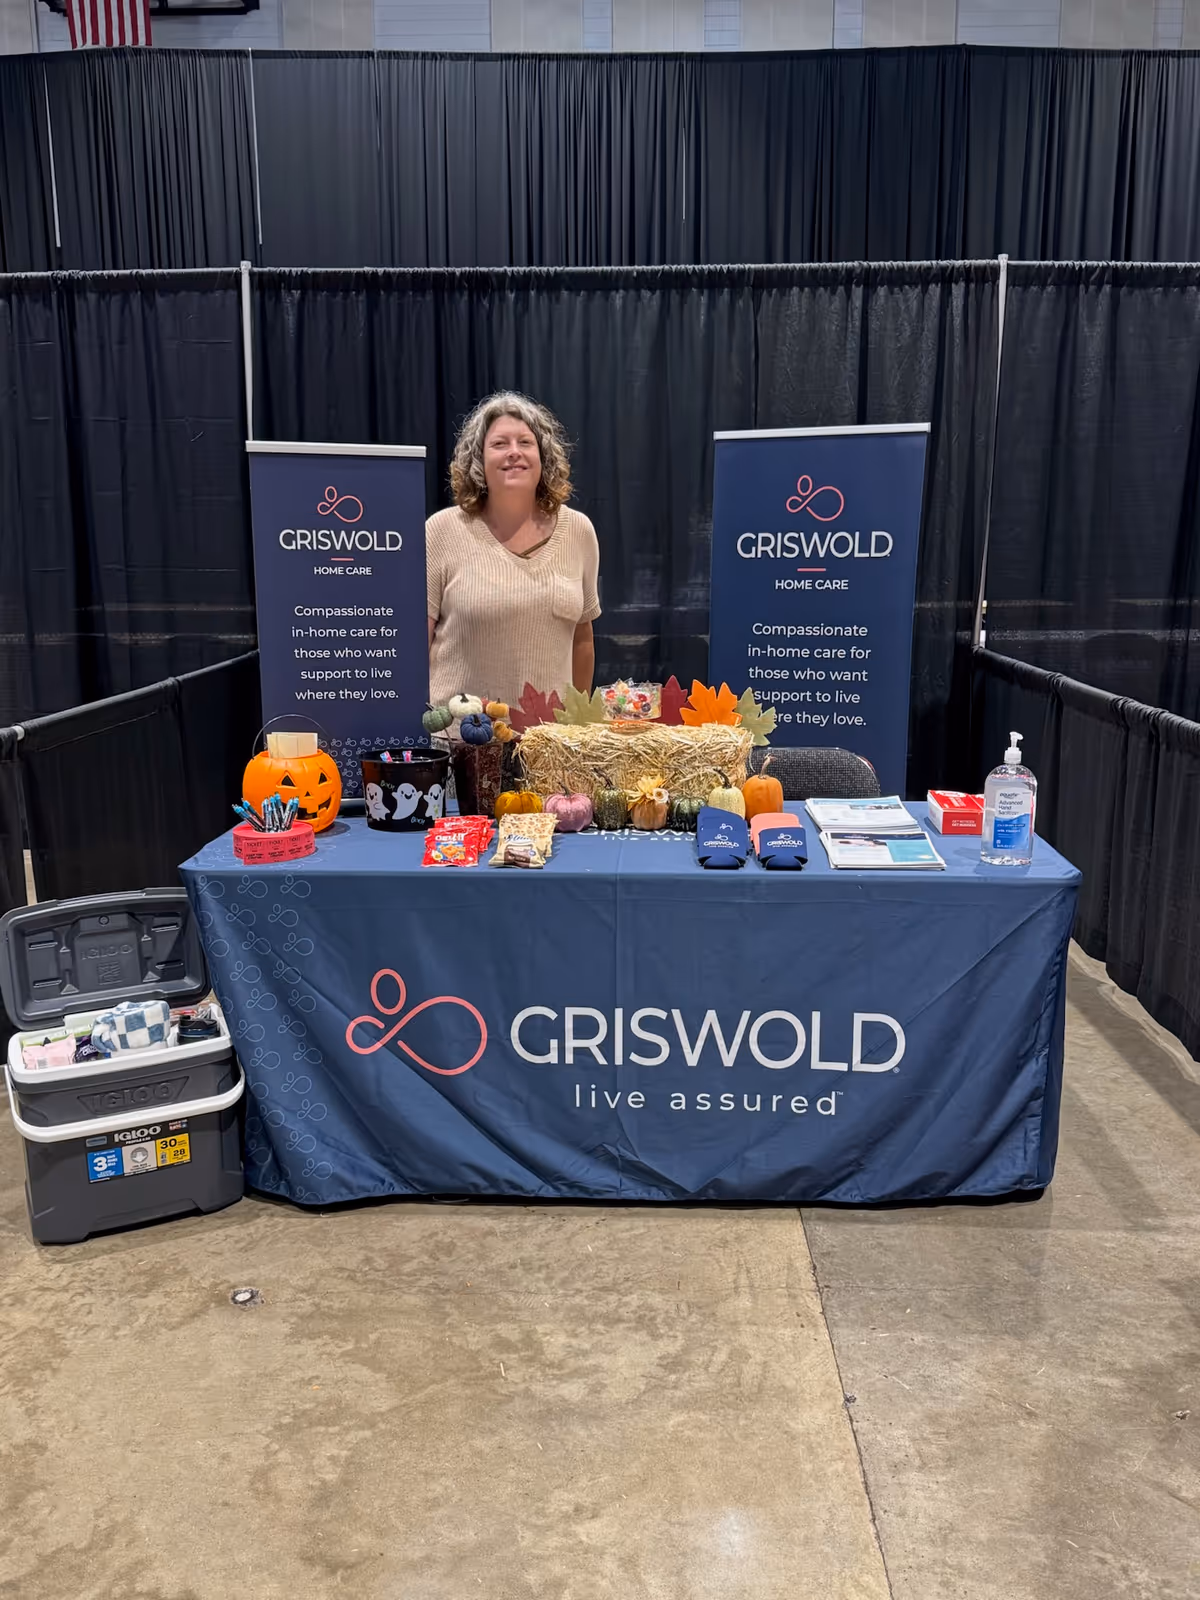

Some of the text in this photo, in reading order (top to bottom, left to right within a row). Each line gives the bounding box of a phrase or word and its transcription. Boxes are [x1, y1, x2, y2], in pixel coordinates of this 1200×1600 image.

[278, 528, 402, 550] GRISWOLD
[736, 530, 893, 558] GRISWOLD
[313, 566, 372, 575] HOME CARE
[775, 579, 848, 589] HOME CARE
[294, 605, 393, 618] Compassionate
[291, 625, 397, 637] in-home care for
[752, 622, 867, 637] Compassionate
[293, 647, 396, 658] those who want
[748, 643, 871, 658] in-home care for
[300, 667, 392, 681] support to live
[748, 666, 867, 681] those who want
[294, 688, 398, 701] where they love.
[753, 690, 860, 704] support to live
[795, 711, 829, 726] they
[833, 712, 866, 725] love.
[510, 1005, 905, 1073] GRISWOLD
[575, 1083, 645, 1108] live
[114, 1126, 161, 1142] IGLOO
[160, 1139, 177, 1149] 30
[173, 1149, 185, 1157] 28
[93, 1156, 108, 1172] 3
